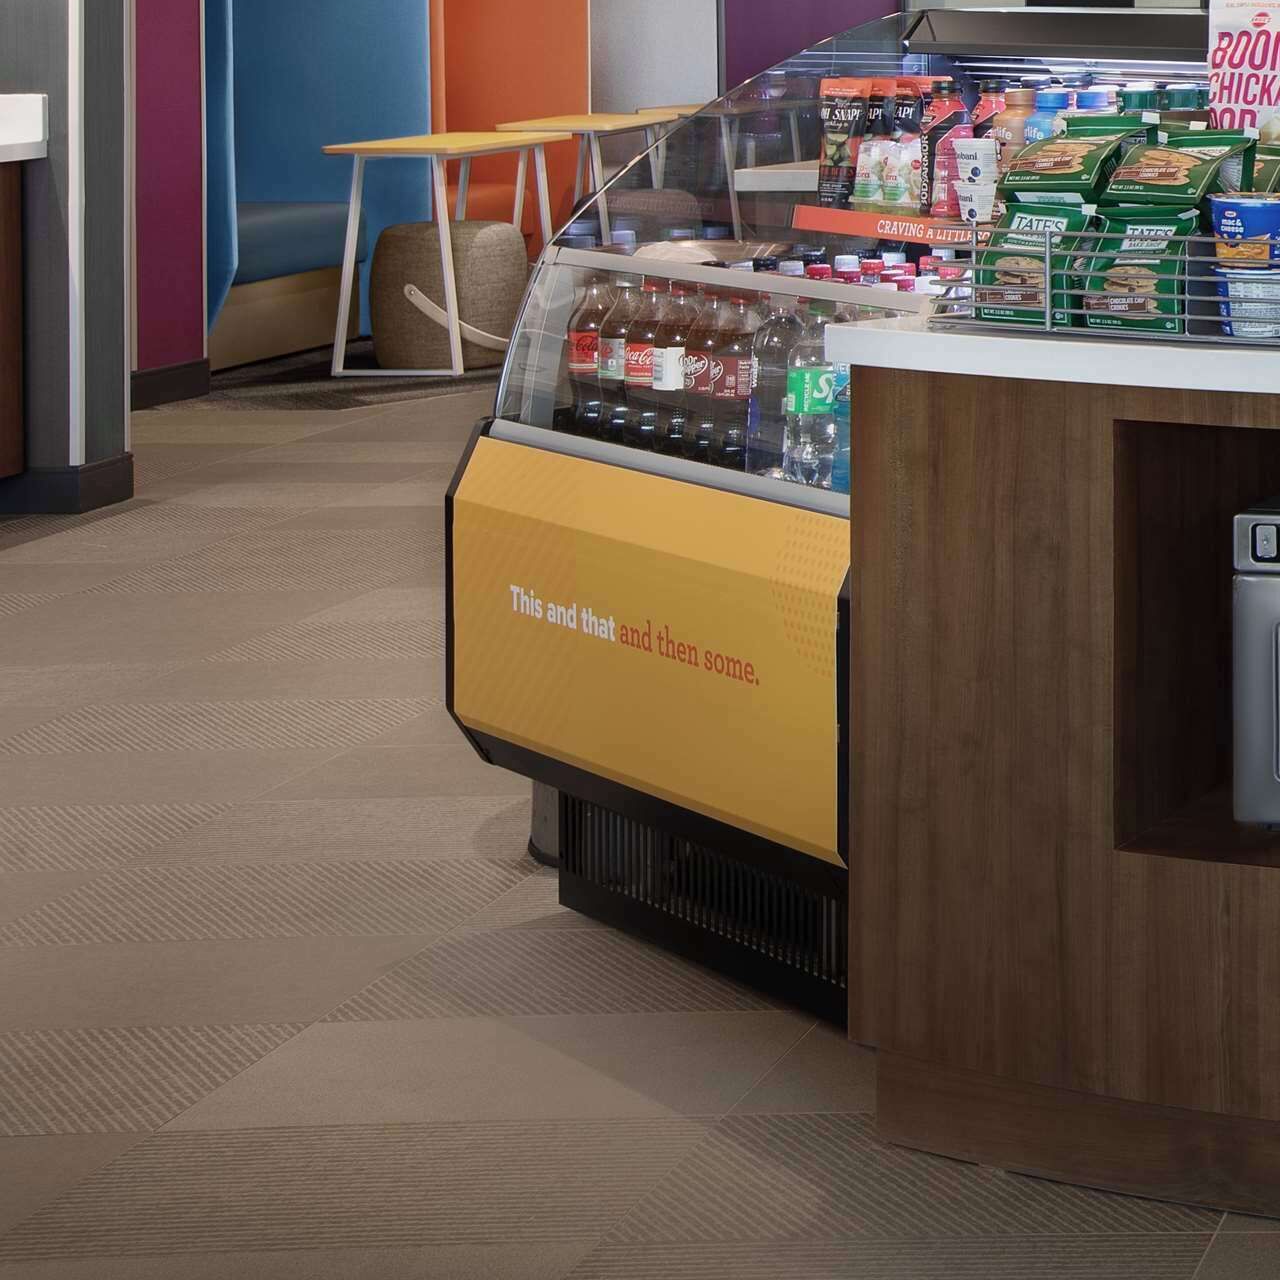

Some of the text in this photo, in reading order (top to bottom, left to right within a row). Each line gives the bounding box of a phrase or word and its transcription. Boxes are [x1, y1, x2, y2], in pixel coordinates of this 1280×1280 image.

[877, 220, 924, 239] CRAVING
[926, 228, 934, 239] A
[751, 355, 759, 388] water
[510, 584, 760, 686] This and that and then some.
